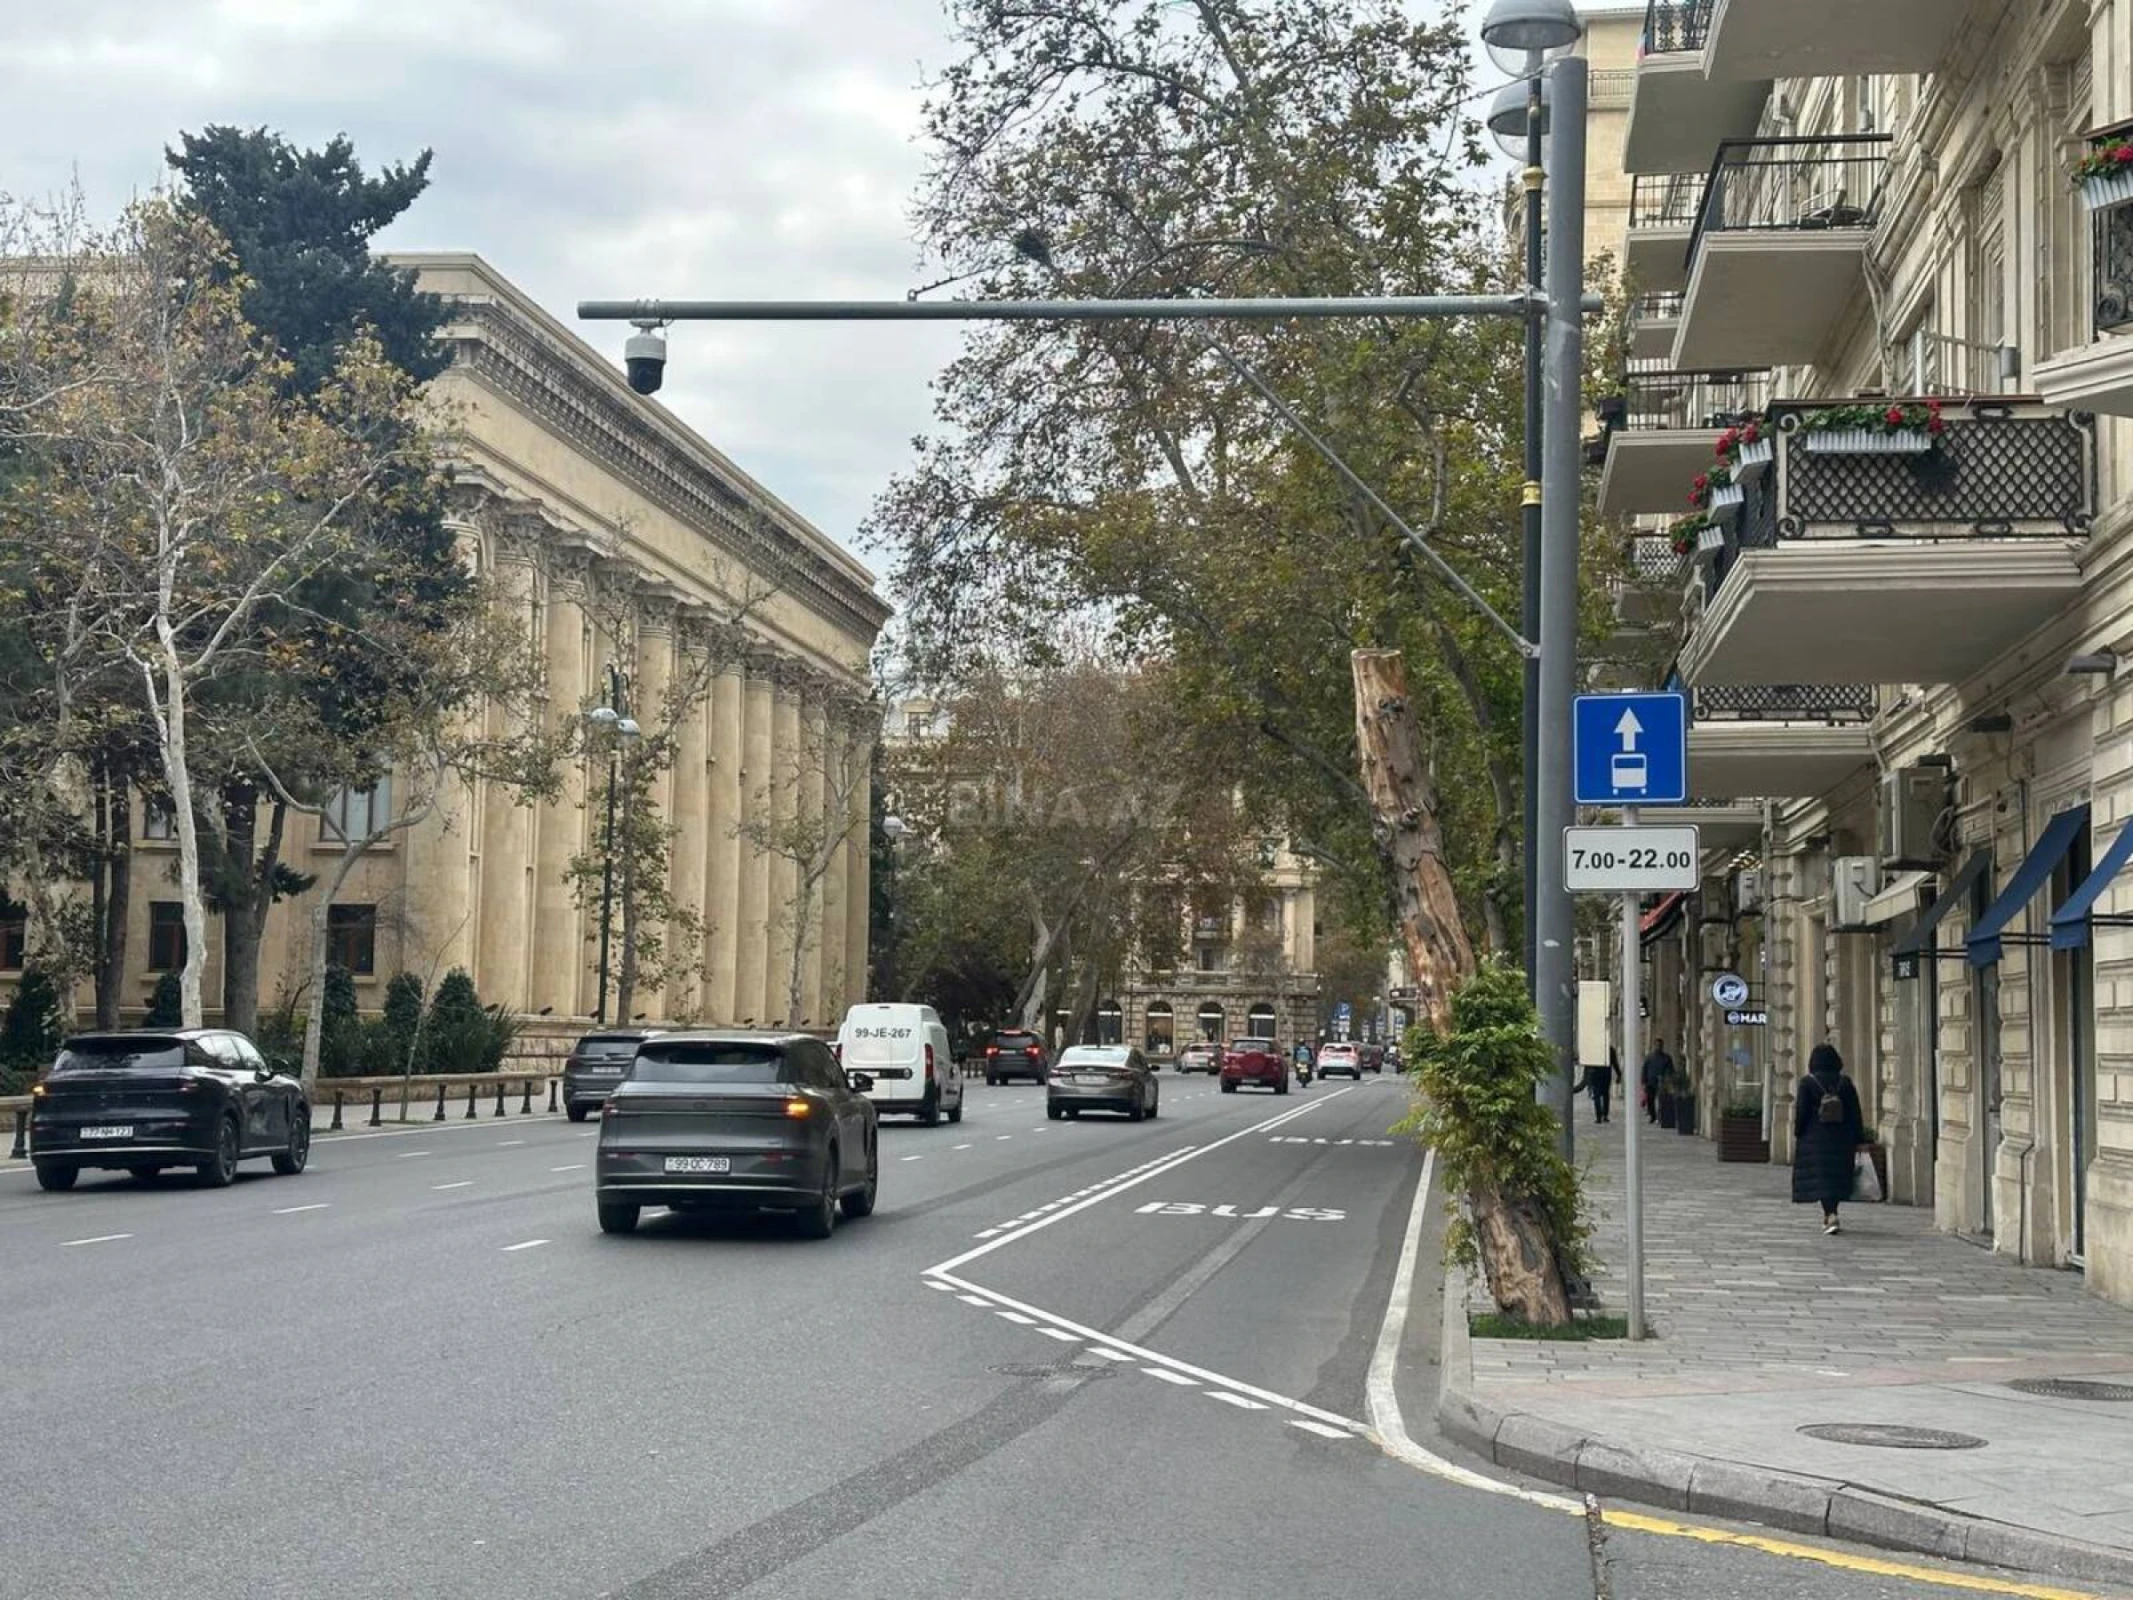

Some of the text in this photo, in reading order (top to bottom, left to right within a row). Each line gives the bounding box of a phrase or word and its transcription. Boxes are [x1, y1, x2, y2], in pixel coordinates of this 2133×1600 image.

[854, 1028, 912, 1039] 99-JE-267
[1268, 1136, 1395, 1146] BUS
[1134, 1201, 1347, 1221] BUS
